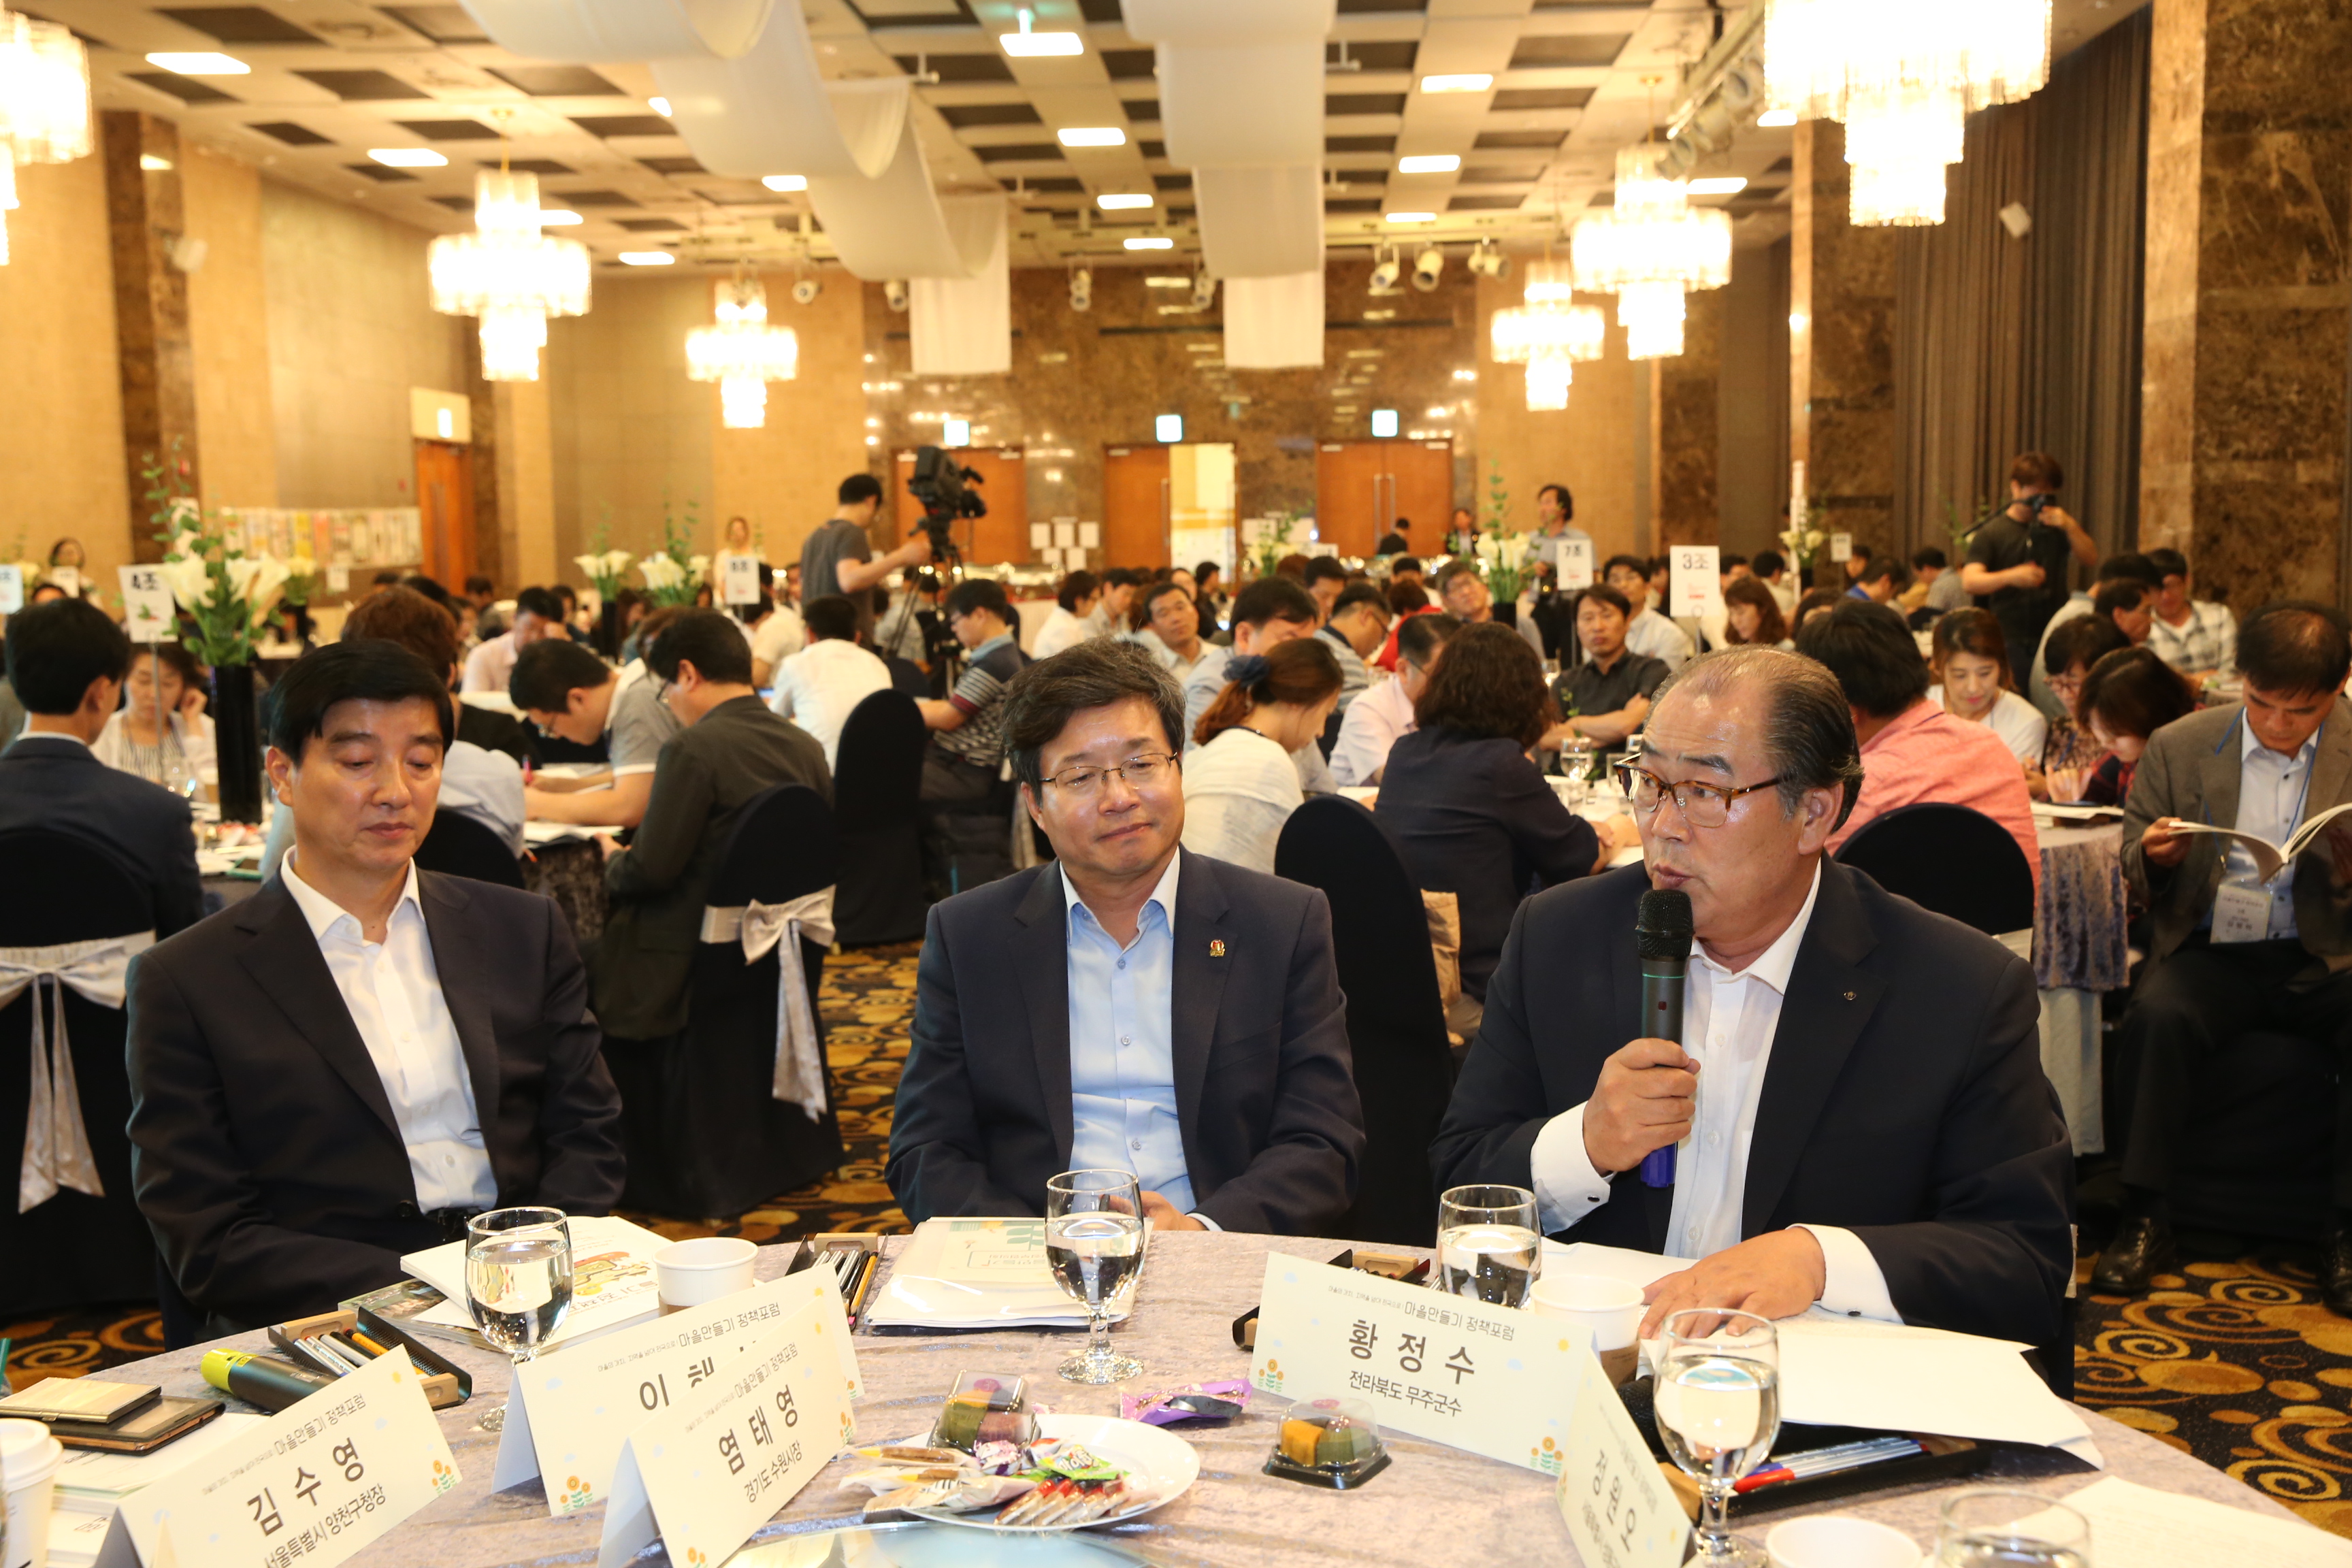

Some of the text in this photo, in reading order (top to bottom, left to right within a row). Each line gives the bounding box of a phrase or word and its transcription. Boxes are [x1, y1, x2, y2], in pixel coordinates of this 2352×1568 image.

[1682, 553, 1710, 570] 3조
[679, 1317, 736, 1348] 마을만들기
[736, 1302, 781, 1328] 정책포럼
[1404, 1301, 1463, 1328] 마을만들기
[1465, 1316, 1516, 1341] 정책포럼
[734, 1342, 798, 1398] 마을만들기 정책포럼
[1349, 1370, 1463, 1418] 전라북도 무주군수
[274, 1393, 367, 1455] 마을만들기 정책포럼
[744, 1439, 803, 1503] 경기도 수원시장
[264, 1483, 386, 1568] 서울특별시 양천구청장
